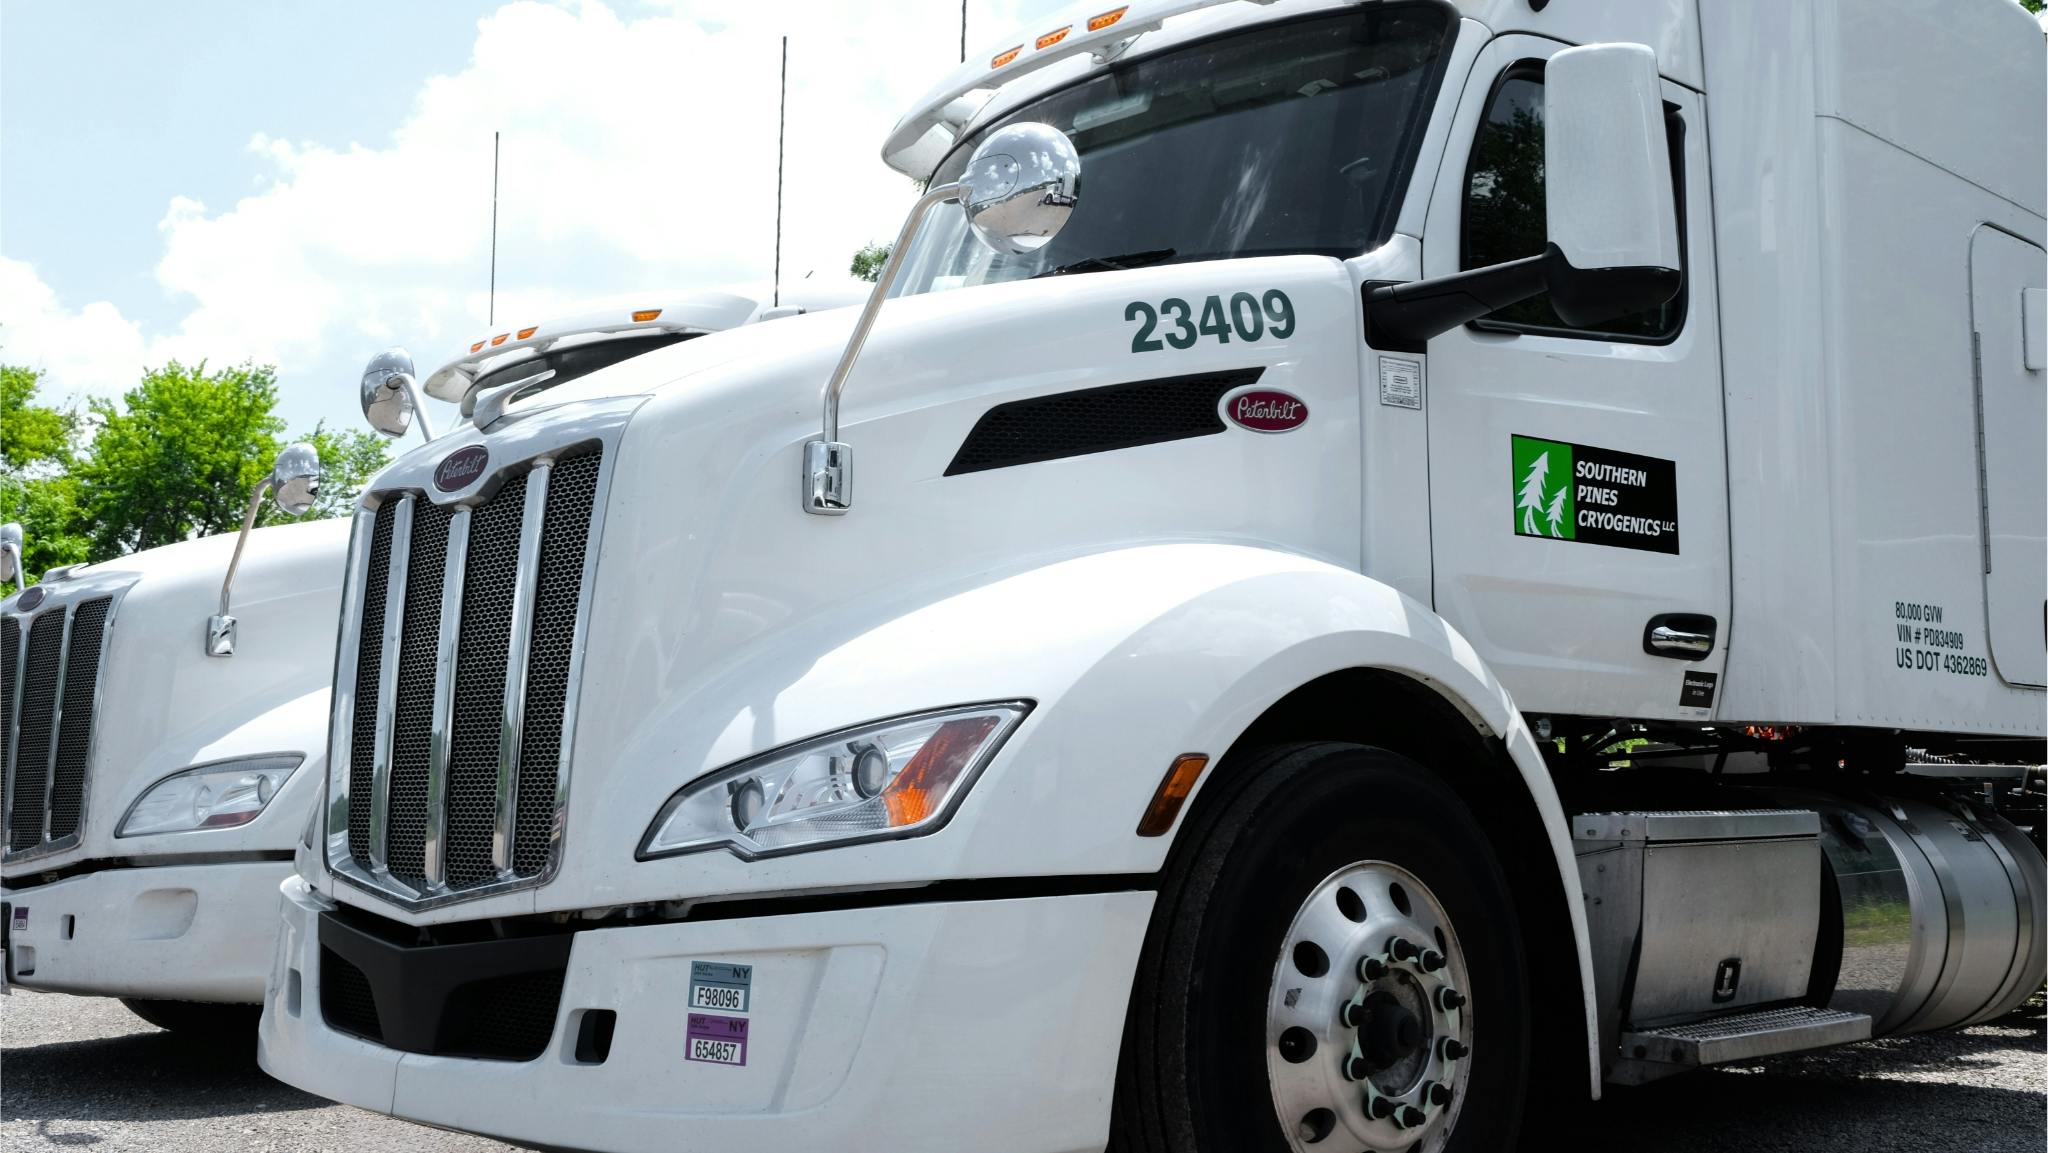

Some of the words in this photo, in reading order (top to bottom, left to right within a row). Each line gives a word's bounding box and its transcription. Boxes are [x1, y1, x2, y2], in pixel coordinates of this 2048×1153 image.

[1125, 289, 1295, 353] 23409
[1237, 396, 1301, 420] Peterbilt
[440, 455, 486, 483] Peterbilt
[1576, 461, 1647, 487] SOUTHERN
[1577, 485, 1618, 506] PINES
[1578, 510, 1660, 536] CRYOGENICS
[1662, 520, 1675, 532] LLC
[1895, 601, 1922, 622] 80,000
[1923, 604, 1943, 623] GVW
[1897, 624, 1912, 643] VIN
[1914, 628, 1921, 644] #
[1924, 628, 1964, 650] PD834909
[1896, 648, 1913, 669] US
[1916, 650, 1940, 672] DOT
[1943, 654, 1987, 677] 4362869
[732, 967, 750, 979] NY
[697, 987, 740, 1009] F98096
[729, 1020, 746, 1033] NY
[695, 1040, 737, 1062] 654857
